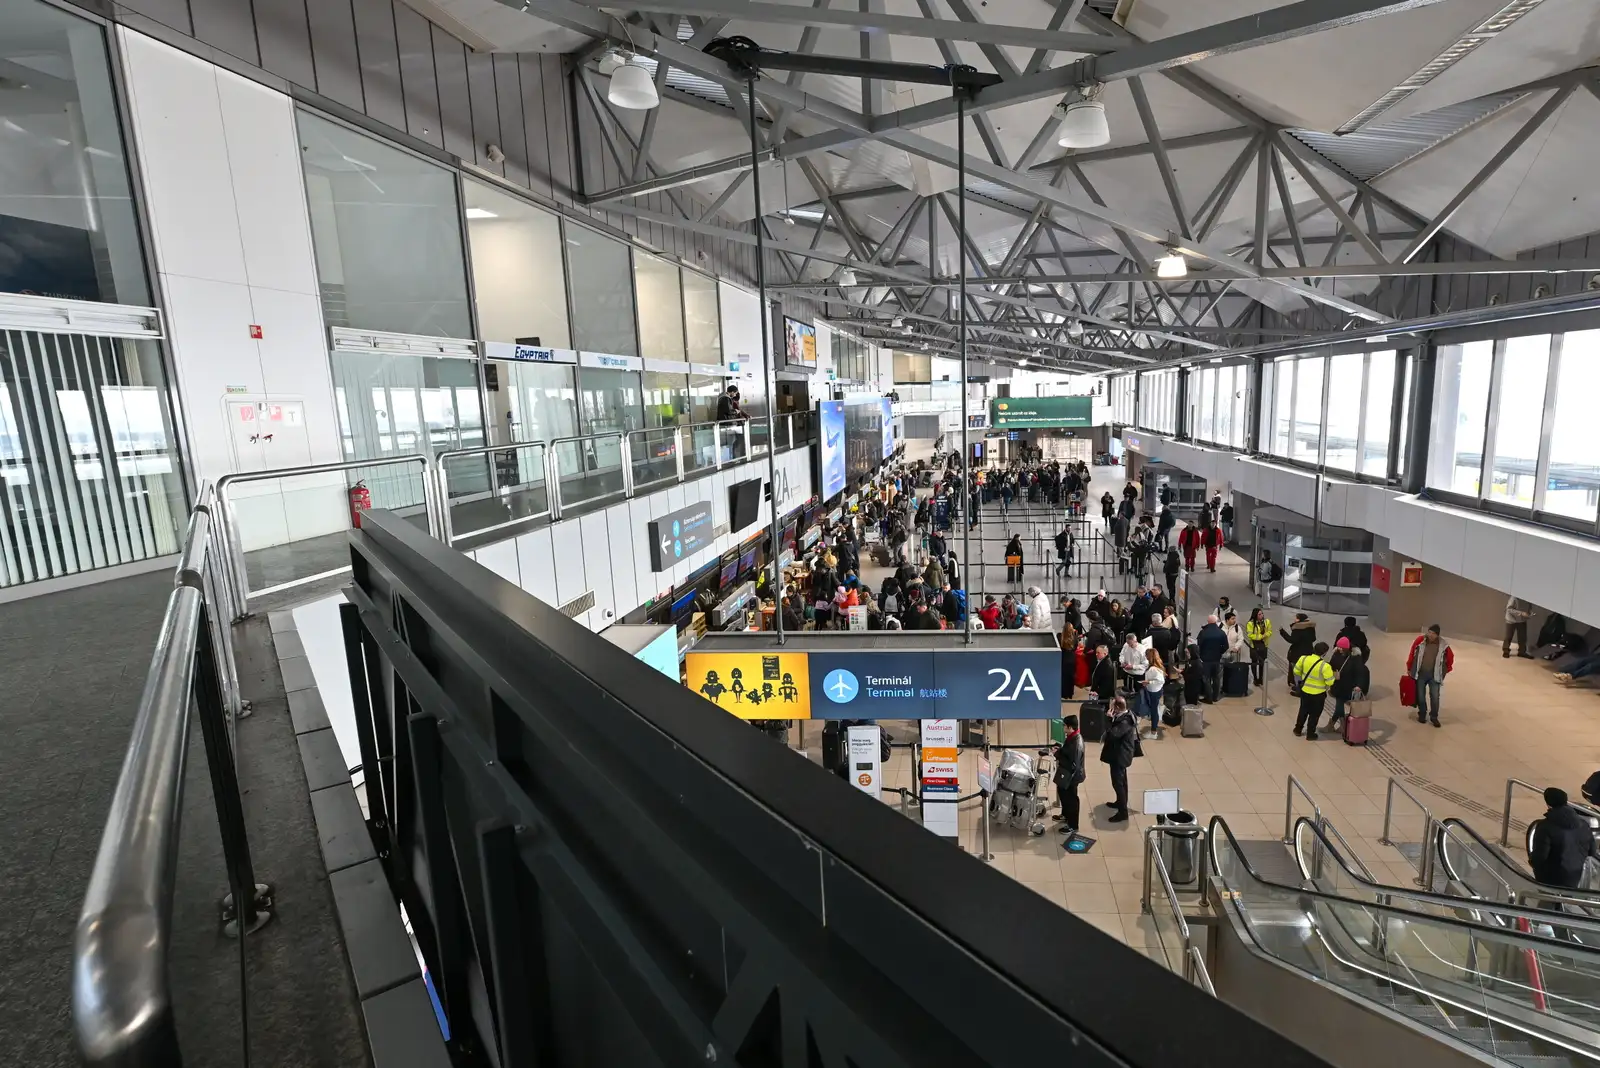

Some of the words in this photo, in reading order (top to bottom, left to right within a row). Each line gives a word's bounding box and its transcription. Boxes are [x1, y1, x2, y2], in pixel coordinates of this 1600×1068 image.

[514, 346, 549, 361] EGYPTAIR
[774, 467, 790, 507] 2A
[866, 676, 912, 686] Terminál
[987, 668, 1044, 701] 2A
[866, 688, 914, 698] Terminal
